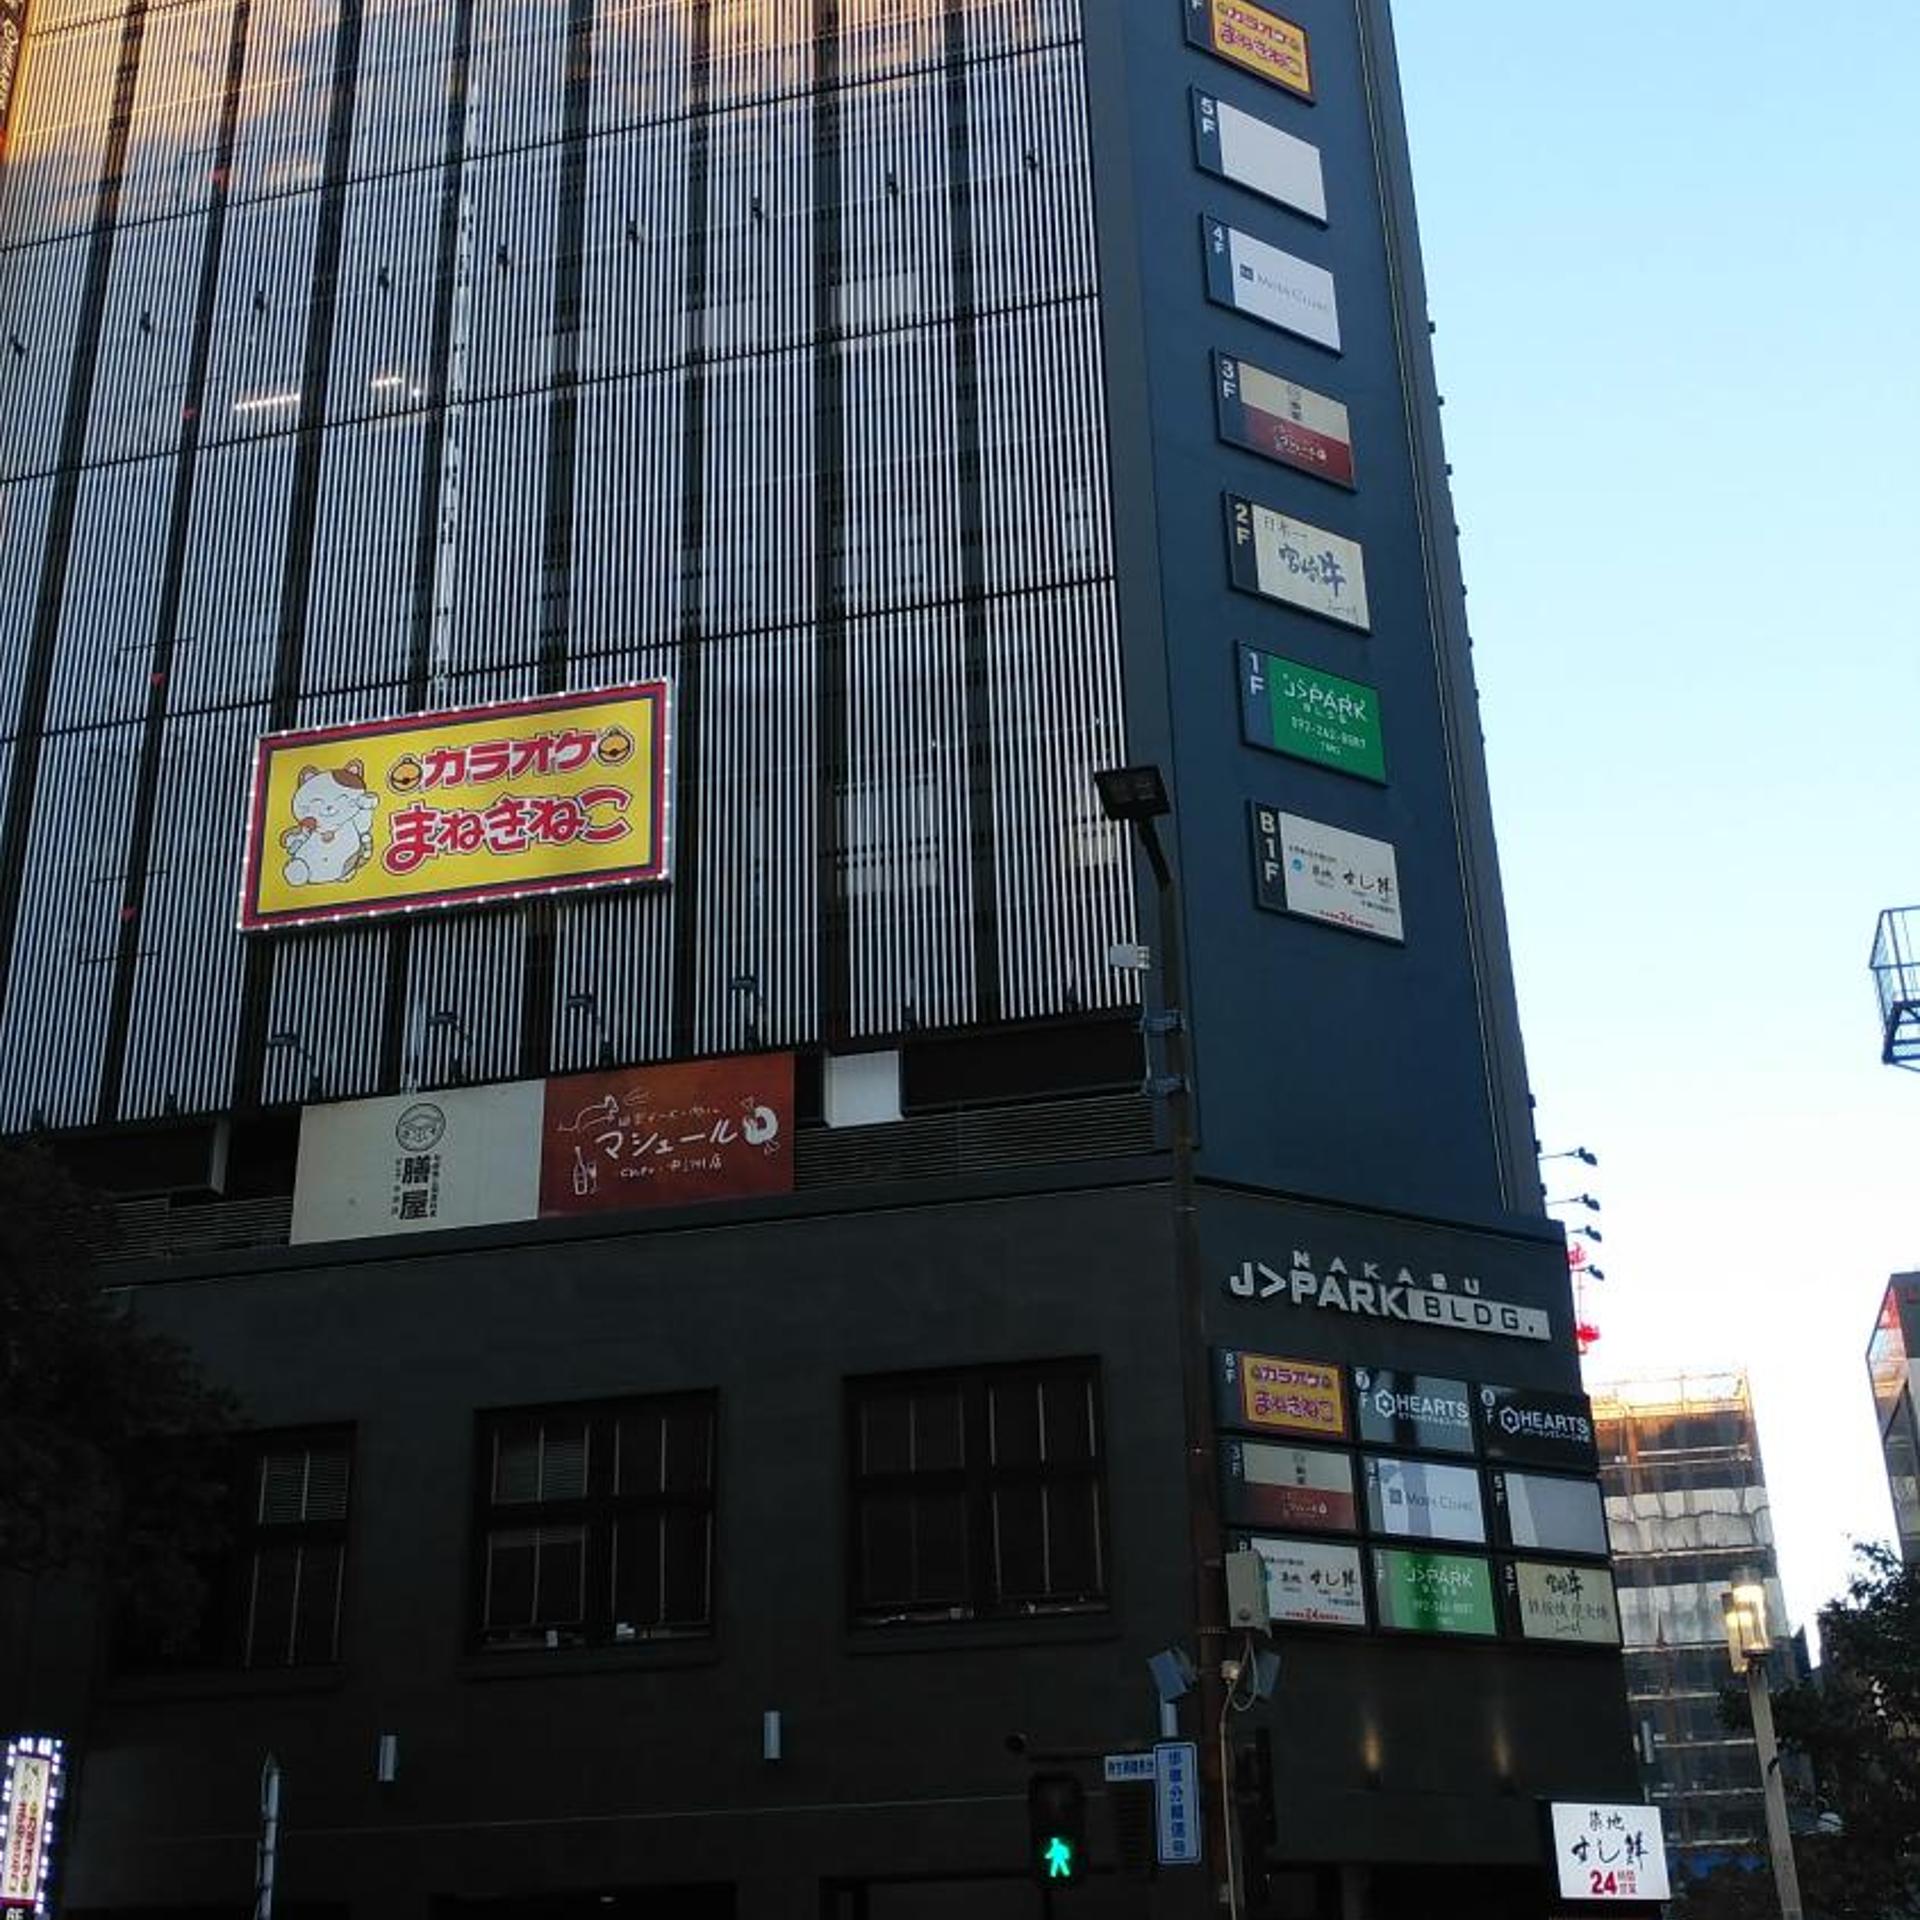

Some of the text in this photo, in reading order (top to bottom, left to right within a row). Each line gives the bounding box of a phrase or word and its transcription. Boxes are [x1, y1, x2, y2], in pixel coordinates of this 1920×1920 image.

[1221, 359, 1236, 398] 3F
[1234, 503, 1250, 545] 2F
[1250, 652, 1264, 695] 1F
[423, 729, 597, 789] カラオケ
[380, 786, 632, 877] まねきねこ
[1259, 811, 1280, 882] B1F
[595, 1119, 738, 1159] マシェール
[1293, 1250, 1480, 1295] NAKABU
[1396, 1393, 1470, 1419] HEARTS
[1520, 1410, 1590, 1435] HEARTS
[1589, 1869, 1618, 1895] 24
